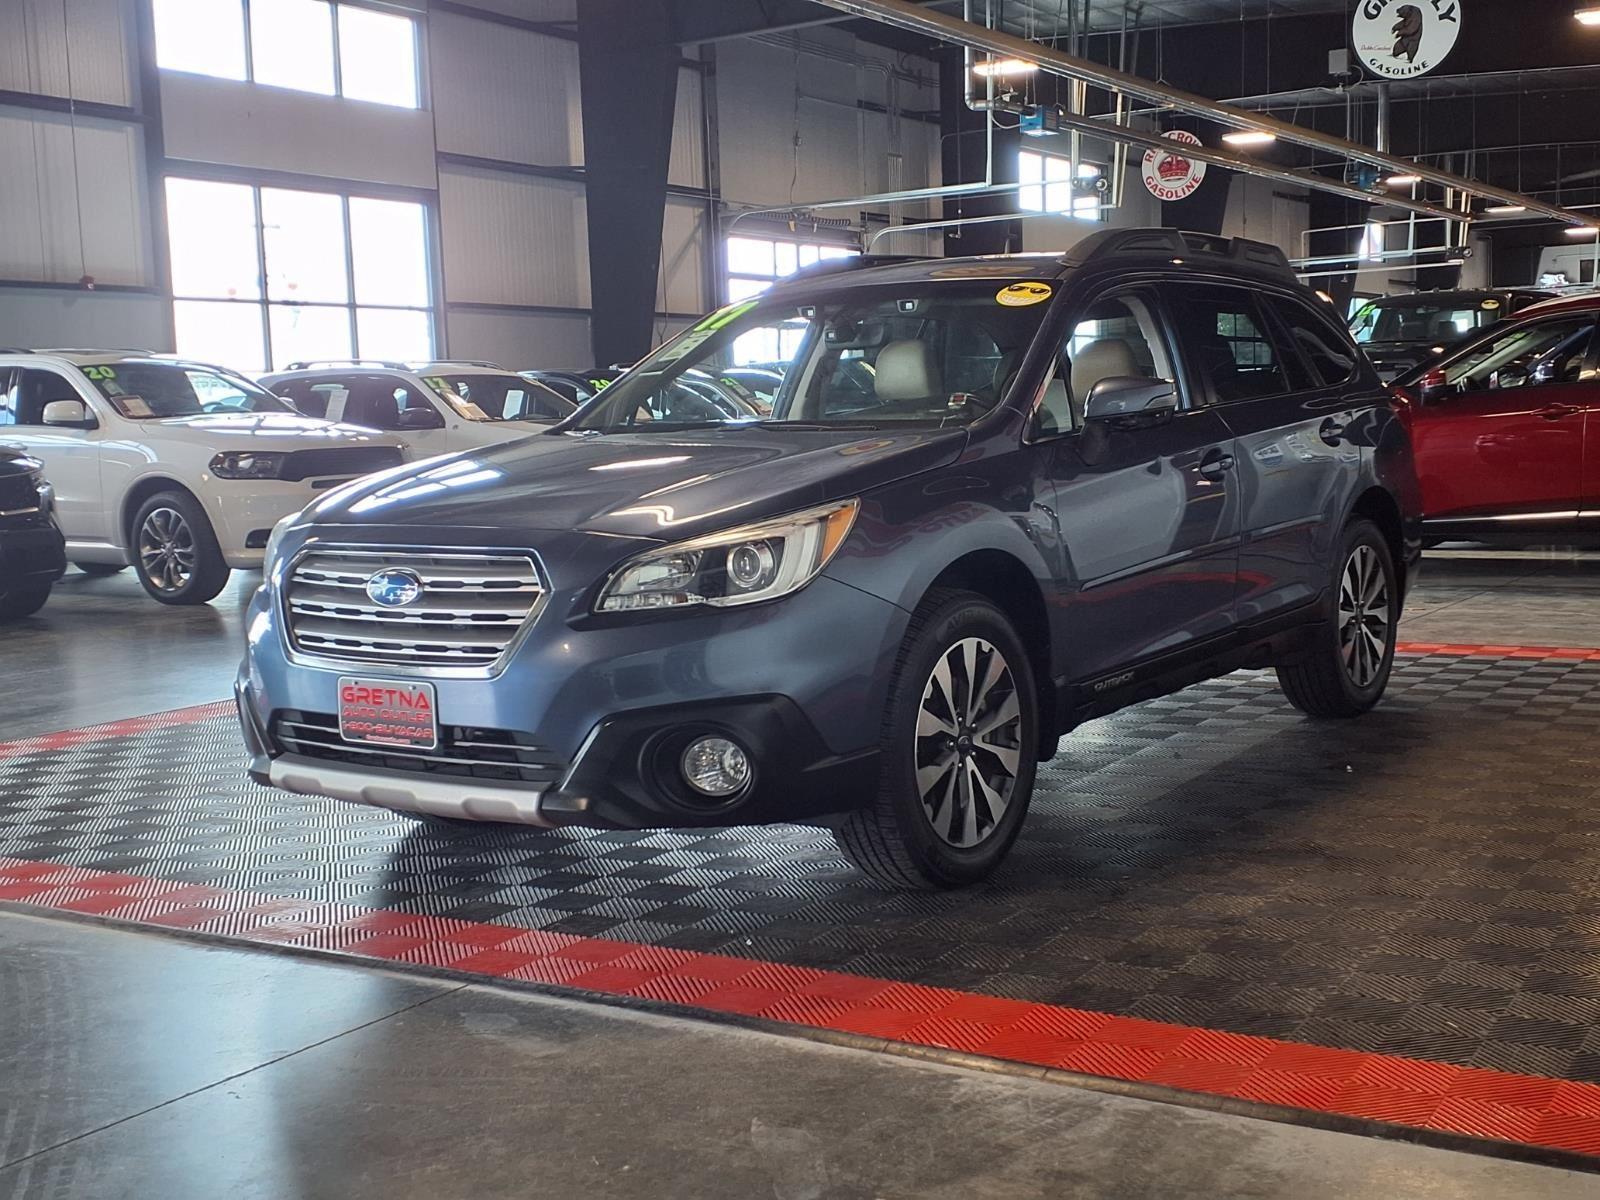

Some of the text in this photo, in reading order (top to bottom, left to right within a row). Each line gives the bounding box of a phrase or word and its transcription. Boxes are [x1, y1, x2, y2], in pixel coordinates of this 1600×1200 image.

[1369, 58, 1429, 75] GASOLINE
[1145, 174, 1201, 199] GASOLINE
[83, 366, 116, 379] 20
[342, 686, 430, 709] GRETNA
[343, 706, 432, 723] AUTO OUTLET
